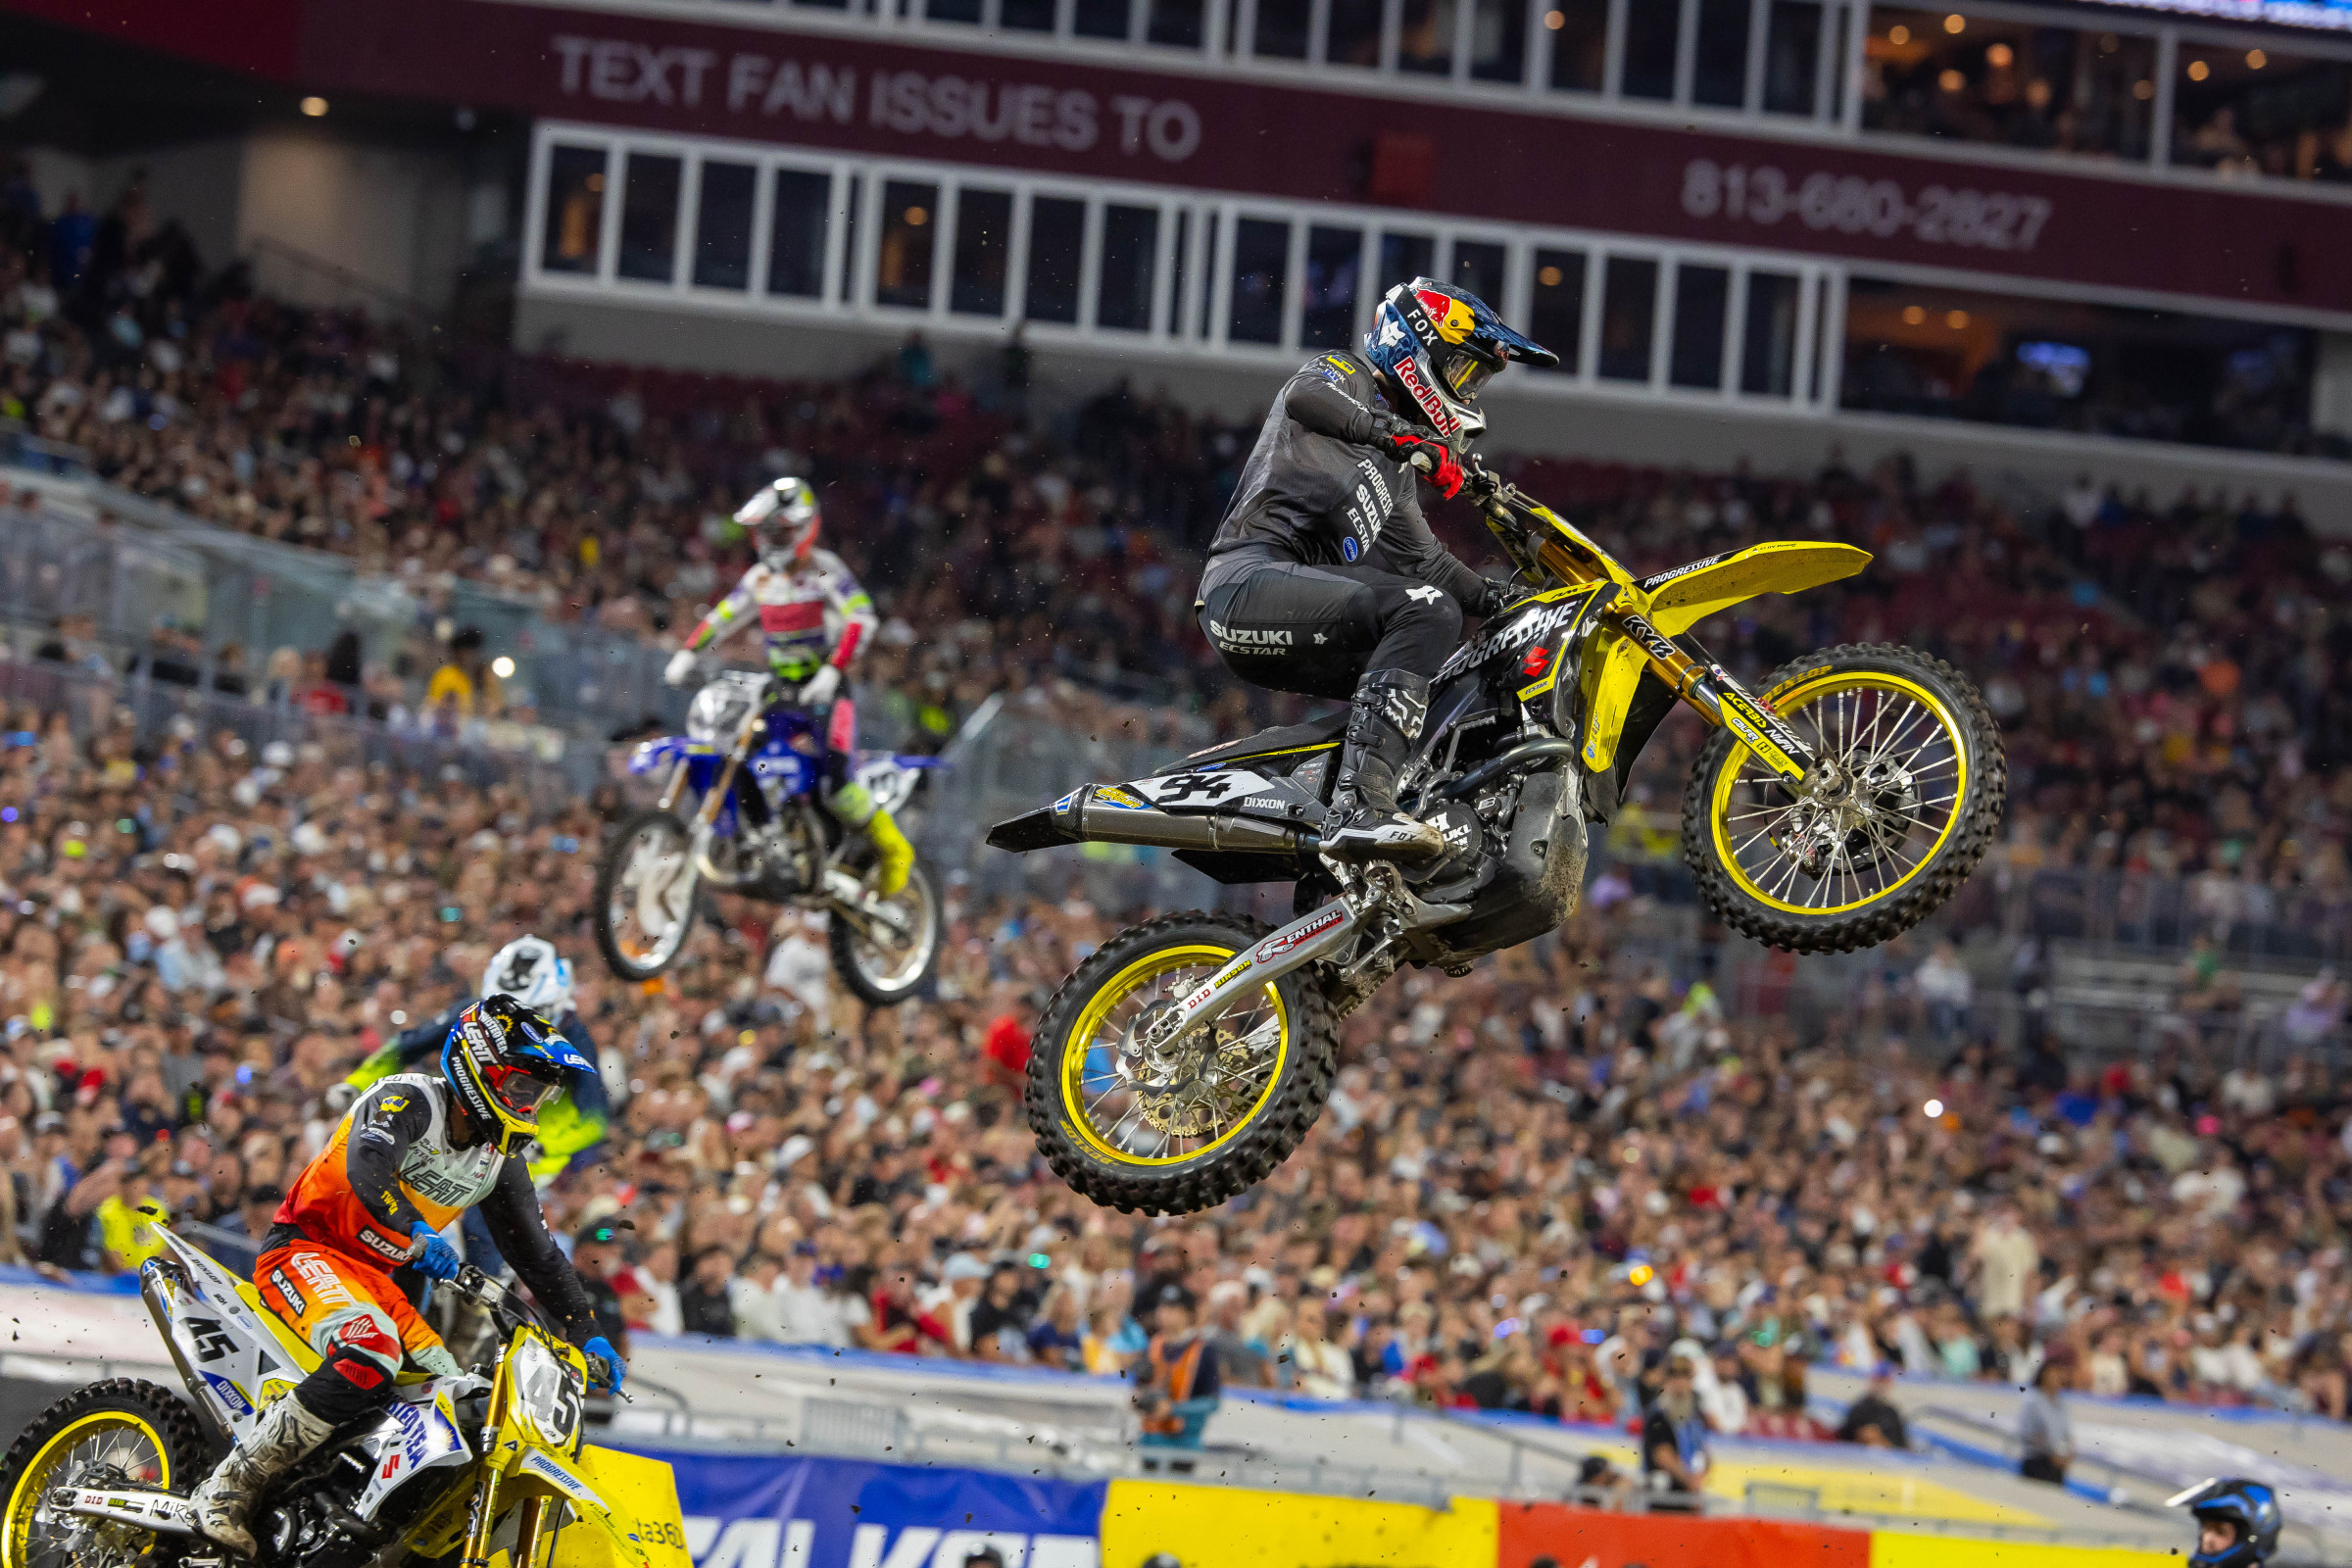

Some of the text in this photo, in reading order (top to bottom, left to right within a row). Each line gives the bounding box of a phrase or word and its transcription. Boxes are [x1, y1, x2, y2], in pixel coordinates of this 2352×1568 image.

[553, 35, 1201, 161] TEXT FAN ISSUES TO
[1682, 160, 2051, 252] 813-680-2827
[1407, 309, 1438, 346] FOX
[1357, 459, 1393, 520] PROGRESSI
[1356, 484, 1381, 543] SUZUK
[1643, 555, 1720, 589] PROGRESSIVE
[1210, 620, 1293, 645] SUZUKI
[1219, 641, 1286, 655] ECSTAR
[1622, 615, 1676, 661] KYB
[1724, 692, 1766, 728] ACERBIS
[1154, 773, 1234, 805] 94
[1244, 797, 1286, 809] DIXXON
[1390, 831, 1416, 841] FOX
[1214, 959, 1252, 988] HINSON
[452, 1056, 492, 1120] PROGRESSIVE
[192, 1259, 222, 1285] DUNLOP
[271, 1270, 306, 1315] SUZUKI
[177, 1317, 240, 1362] 45
[217, 1380, 246, 1410] DIXXON
[526, 1363, 578, 1437] 45
[530, 1456, 582, 1490] PROGRESSIVE
